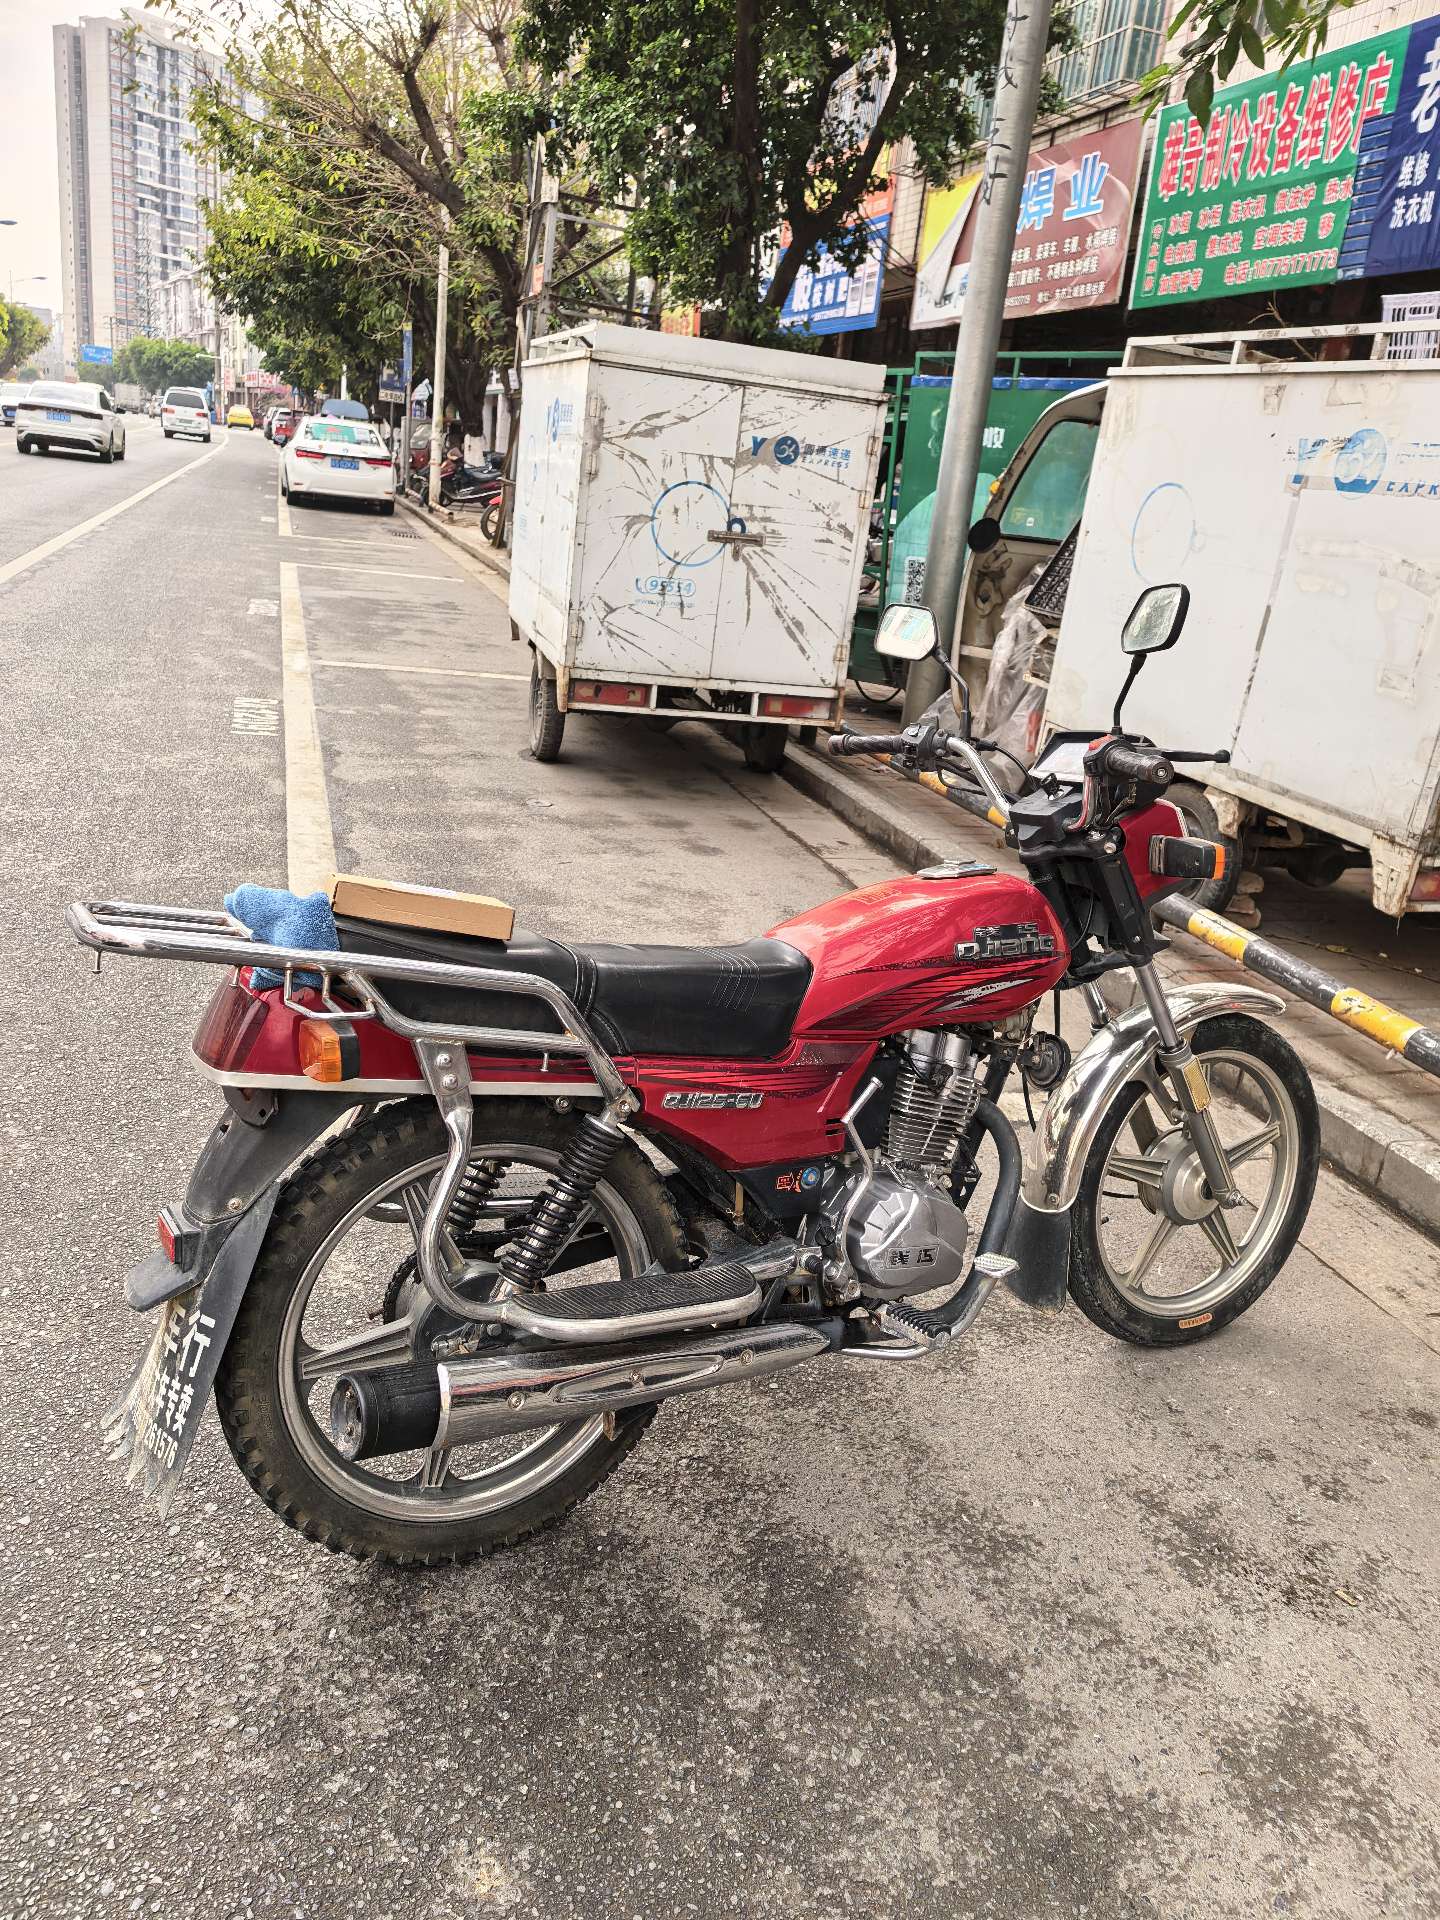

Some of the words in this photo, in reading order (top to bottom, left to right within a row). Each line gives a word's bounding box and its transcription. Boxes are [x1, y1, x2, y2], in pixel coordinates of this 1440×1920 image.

[1158, 51, 1393, 201] 雄哥制冷设备维修店
[1398, 151, 1430, 189] 维修
[1167, 210, 1193, 236] 冰箱
[1196, 203, 1224, 230] 冰柜
[1227, 193, 1268, 224] 洗衣机
[1273, 182, 1318, 215] 微波炉
[1389, 190, 1436, 230] 洗衣机
[1163, 239, 1198, 266] 电视机
[1251, 217, 1308, 251] 空调安装
[648, 580, 693, 597] 95554
